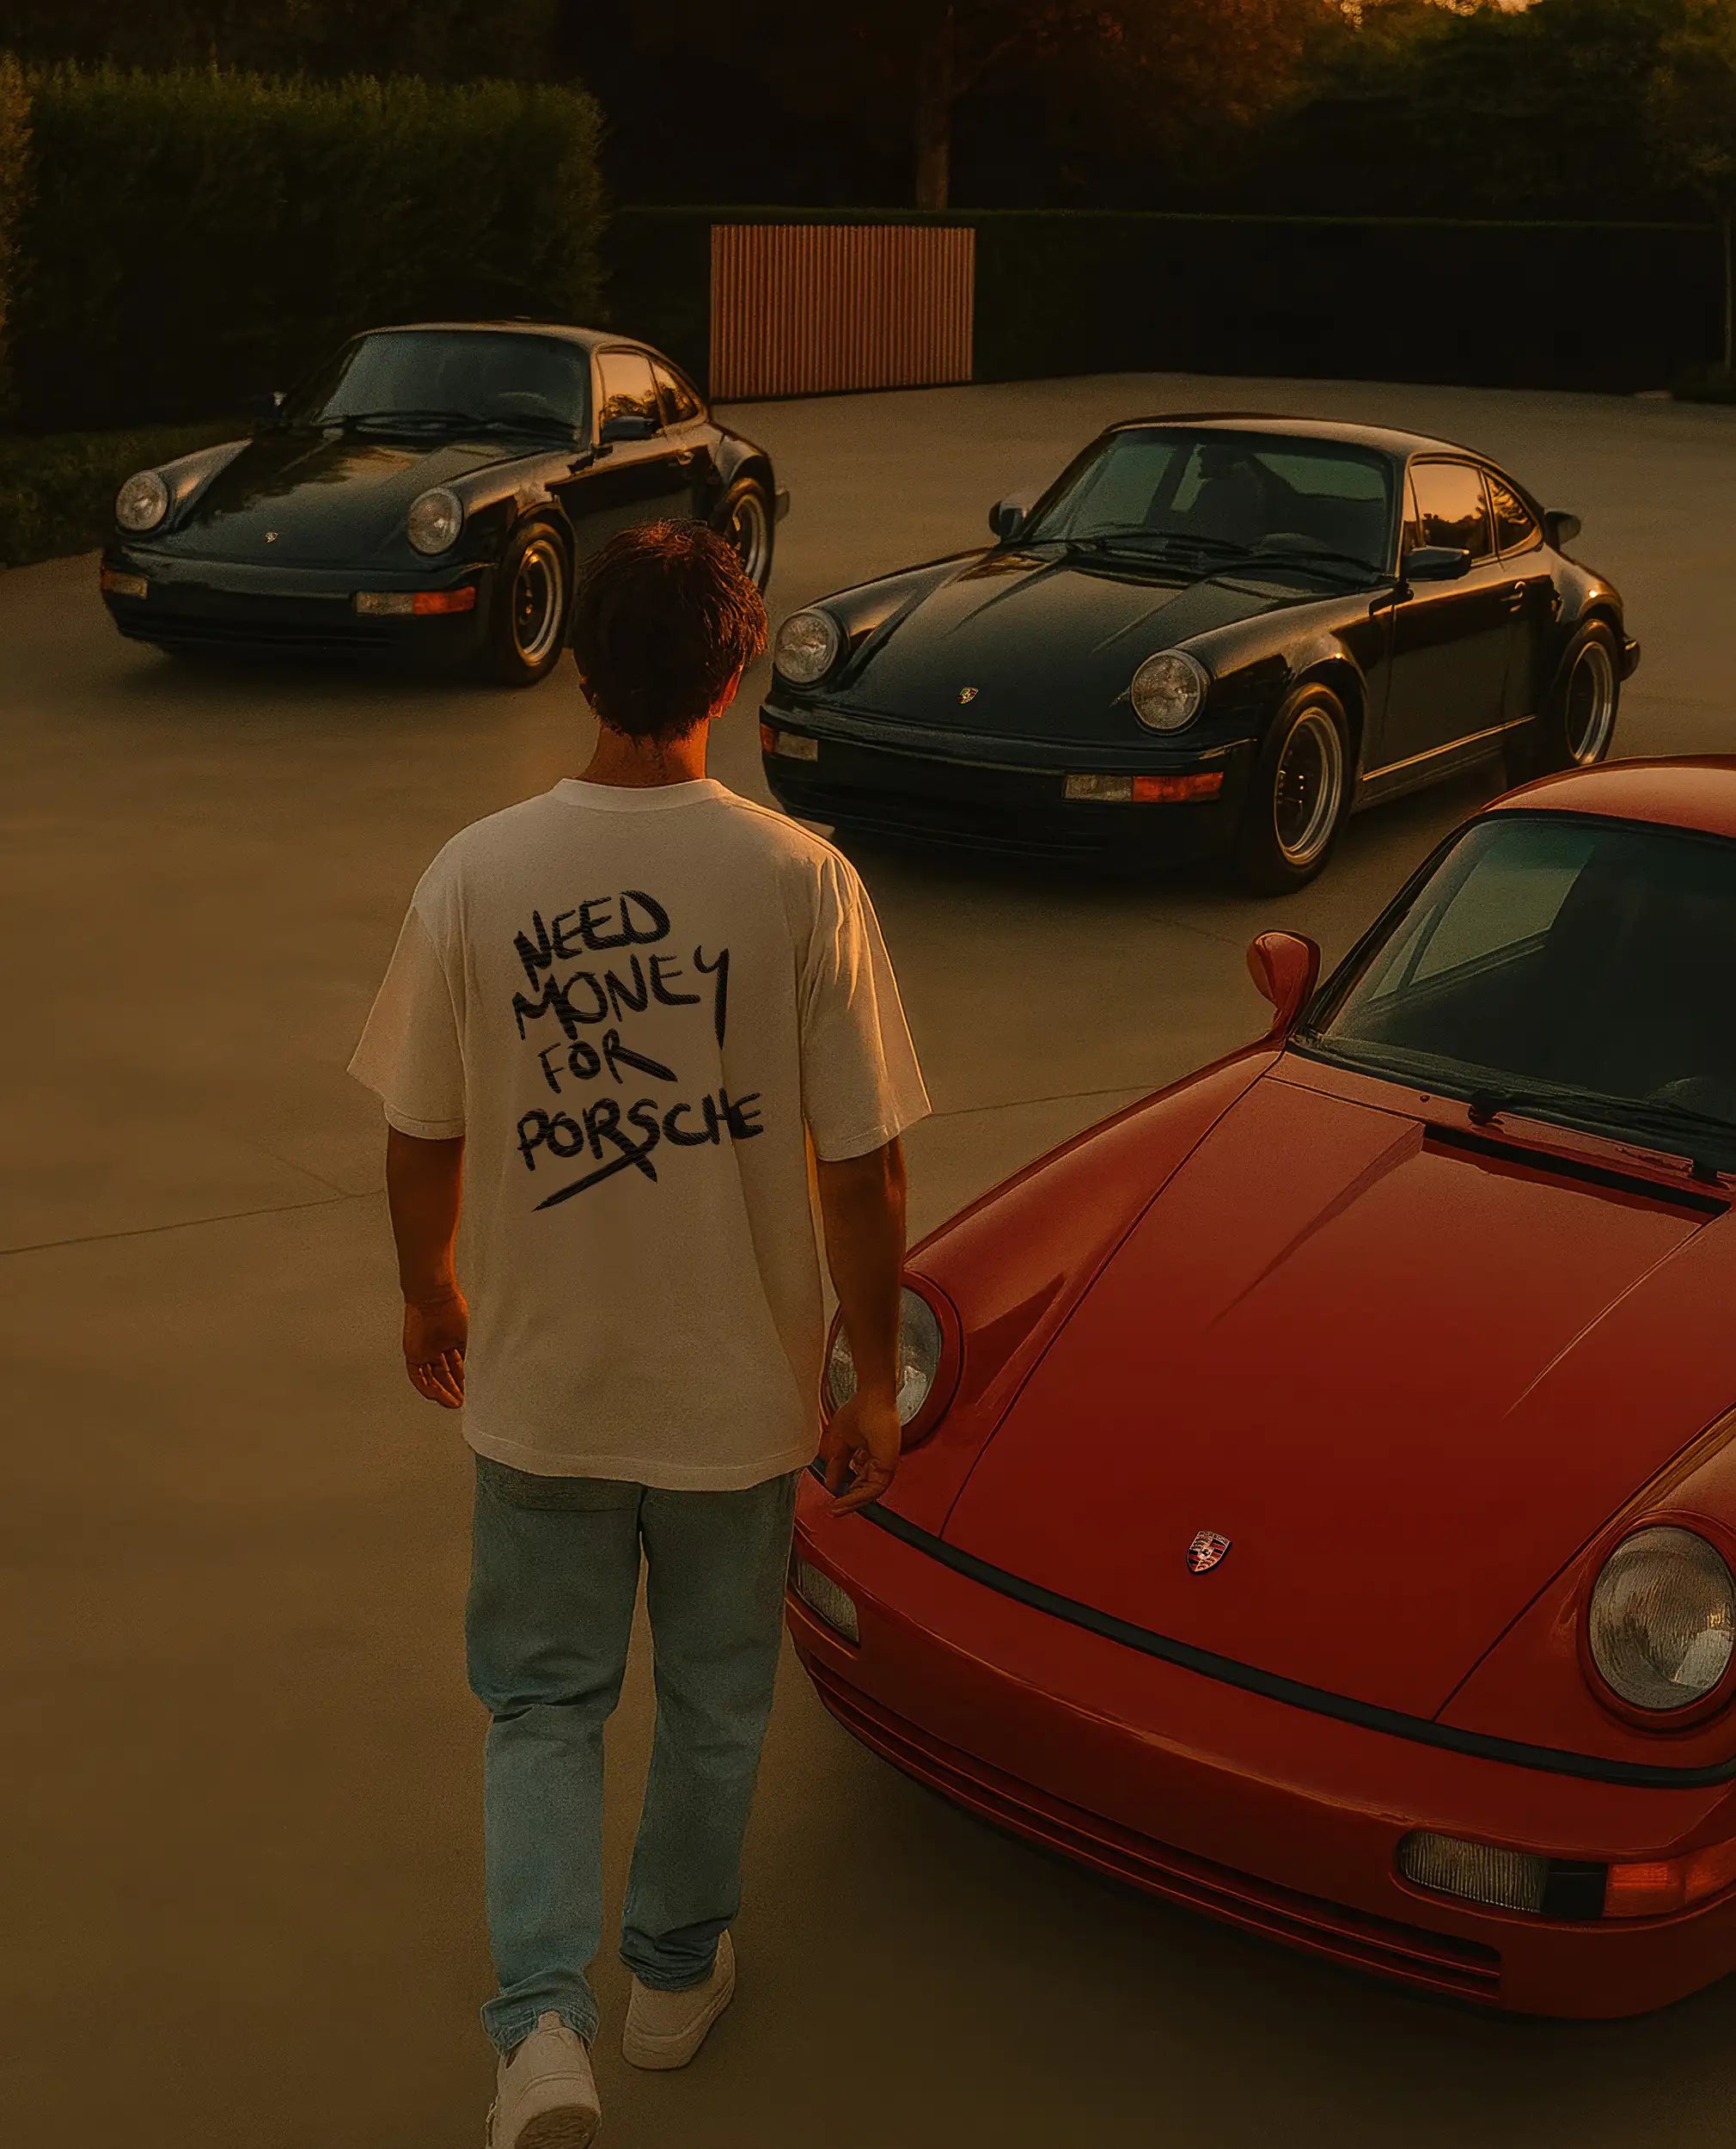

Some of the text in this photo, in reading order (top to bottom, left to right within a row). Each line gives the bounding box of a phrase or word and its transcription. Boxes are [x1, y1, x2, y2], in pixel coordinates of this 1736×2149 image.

[513, 889, 671, 993] NEED
[511, 945, 730, 1050] MONEY
[537, 1027, 679, 1094] FOR
[516, 1087, 765, 1213] PORSCHE
